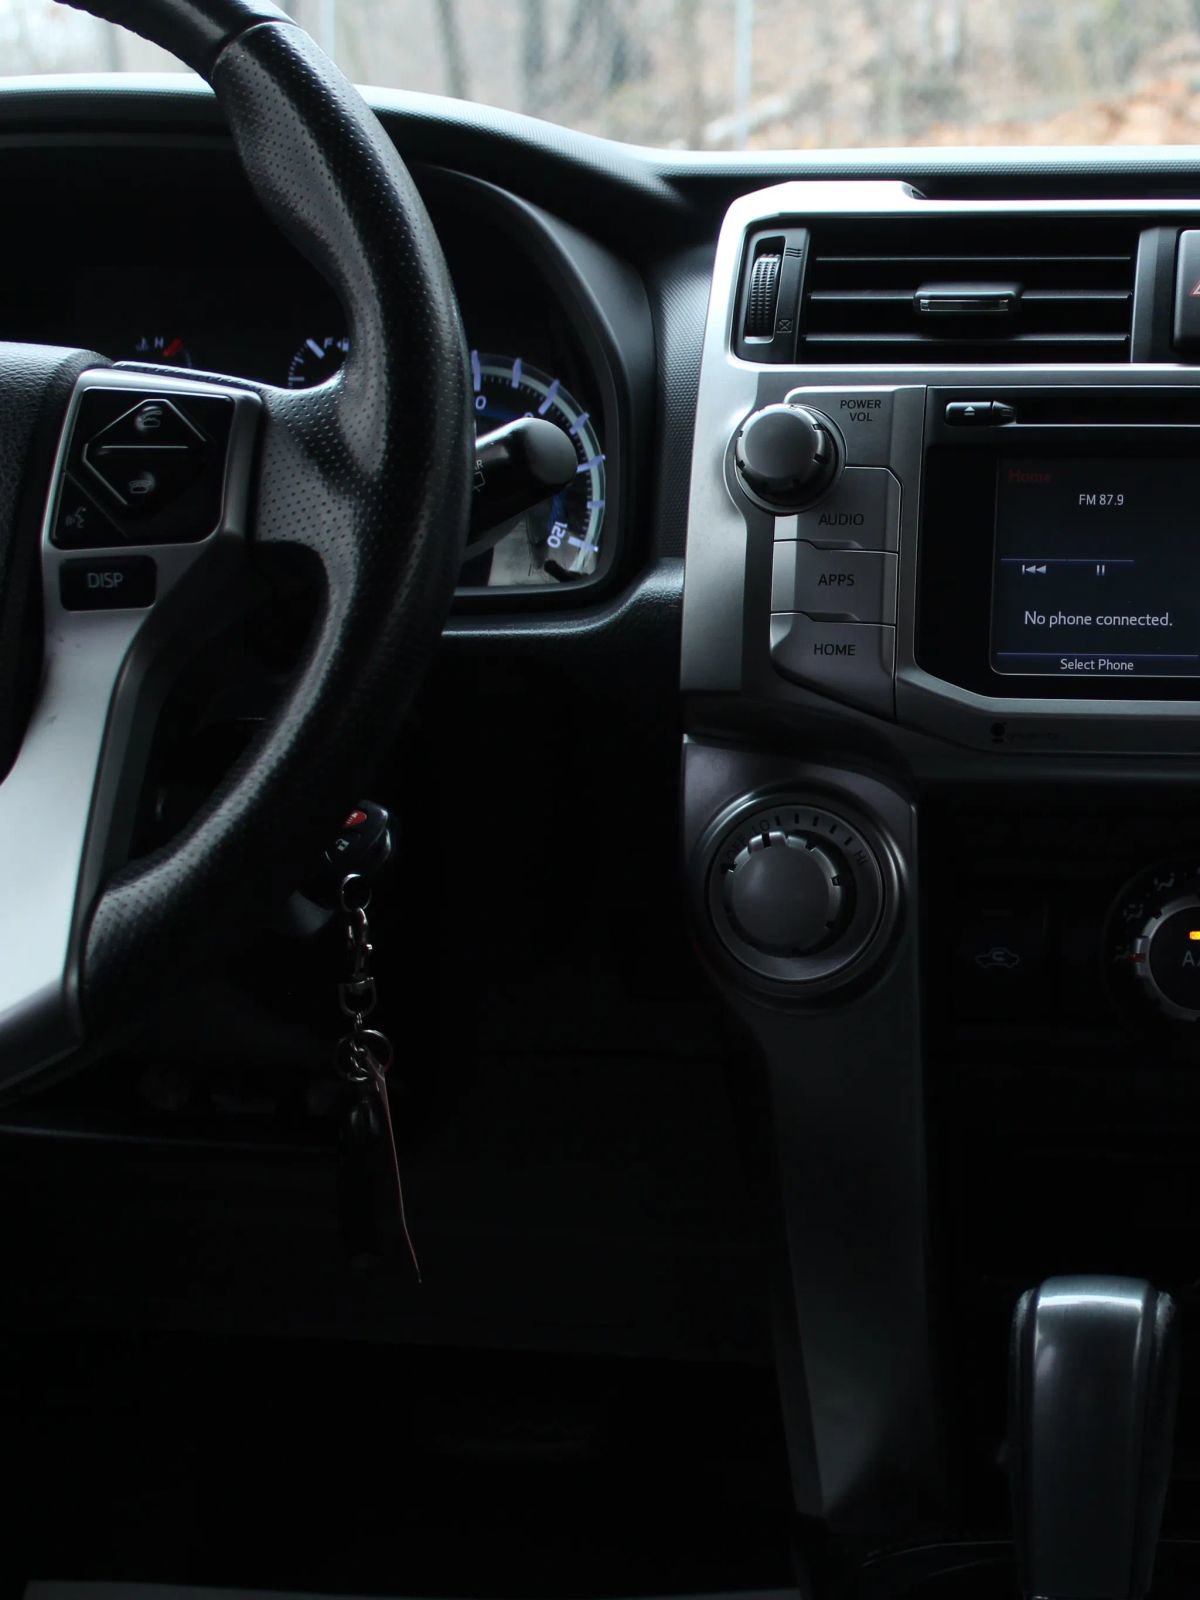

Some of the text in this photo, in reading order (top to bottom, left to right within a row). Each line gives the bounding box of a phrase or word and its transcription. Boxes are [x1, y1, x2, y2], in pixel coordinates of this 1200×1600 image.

[840, 400, 881, 409] POWER
[849, 412, 872, 422] VOL
[1078, 493, 1124, 506] FM 87.9
[818, 514, 864, 526] AUDIO
[546, 521, 568, 549] 120
[87, 572, 124, 588] DISP
[818, 573, 855, 586] APPS
[1024, 610, 1173, 628] No phone connected.
[814, 643, 856, 655] HOME
[1060, 658, 1134, 671] Select Phone
